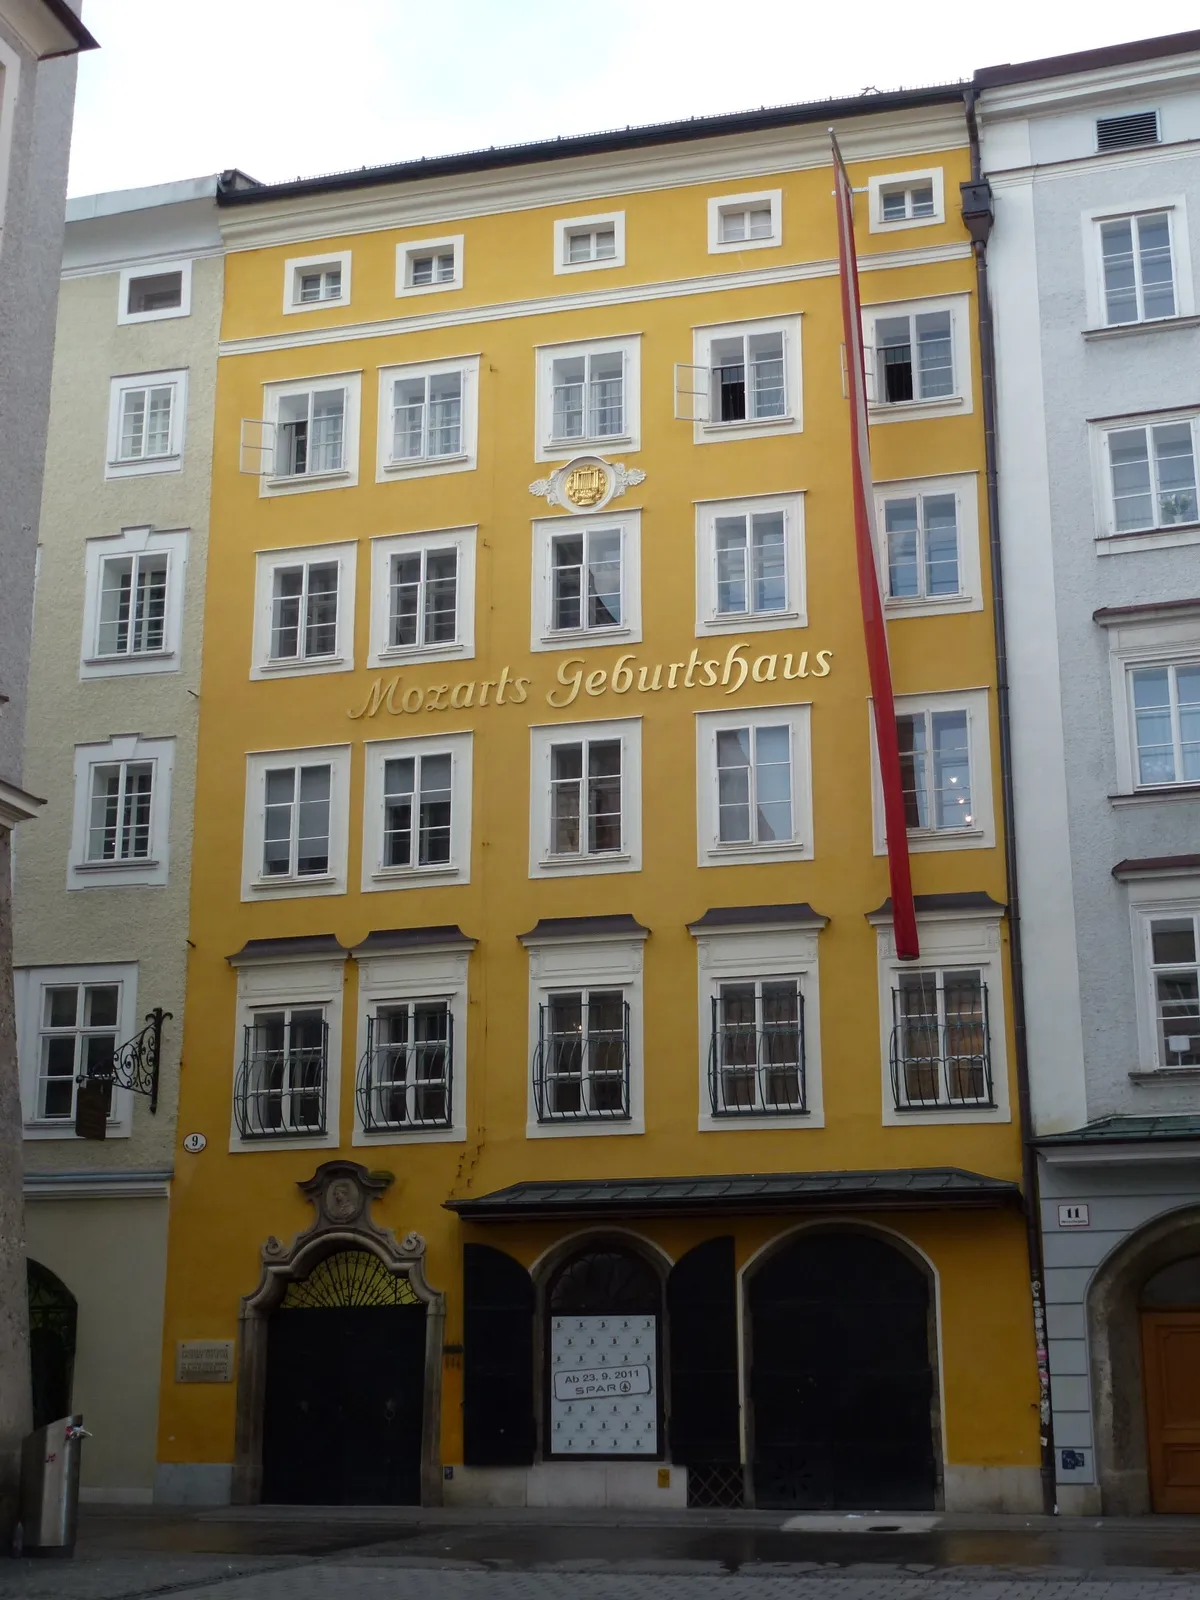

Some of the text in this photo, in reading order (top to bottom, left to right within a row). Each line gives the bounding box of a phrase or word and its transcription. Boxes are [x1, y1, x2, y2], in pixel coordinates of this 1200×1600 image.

[347, 643, 833, 719] Mozarts Geburtshaus
[192, 1135, 198, 1146] 9
[1066, 1208, 1080, 1218] 11
[565, 1374, 579, 1384] Ab
[615, 1369, 639, 1379] 2011
[575, 1384, 616, 1394] SPAR
